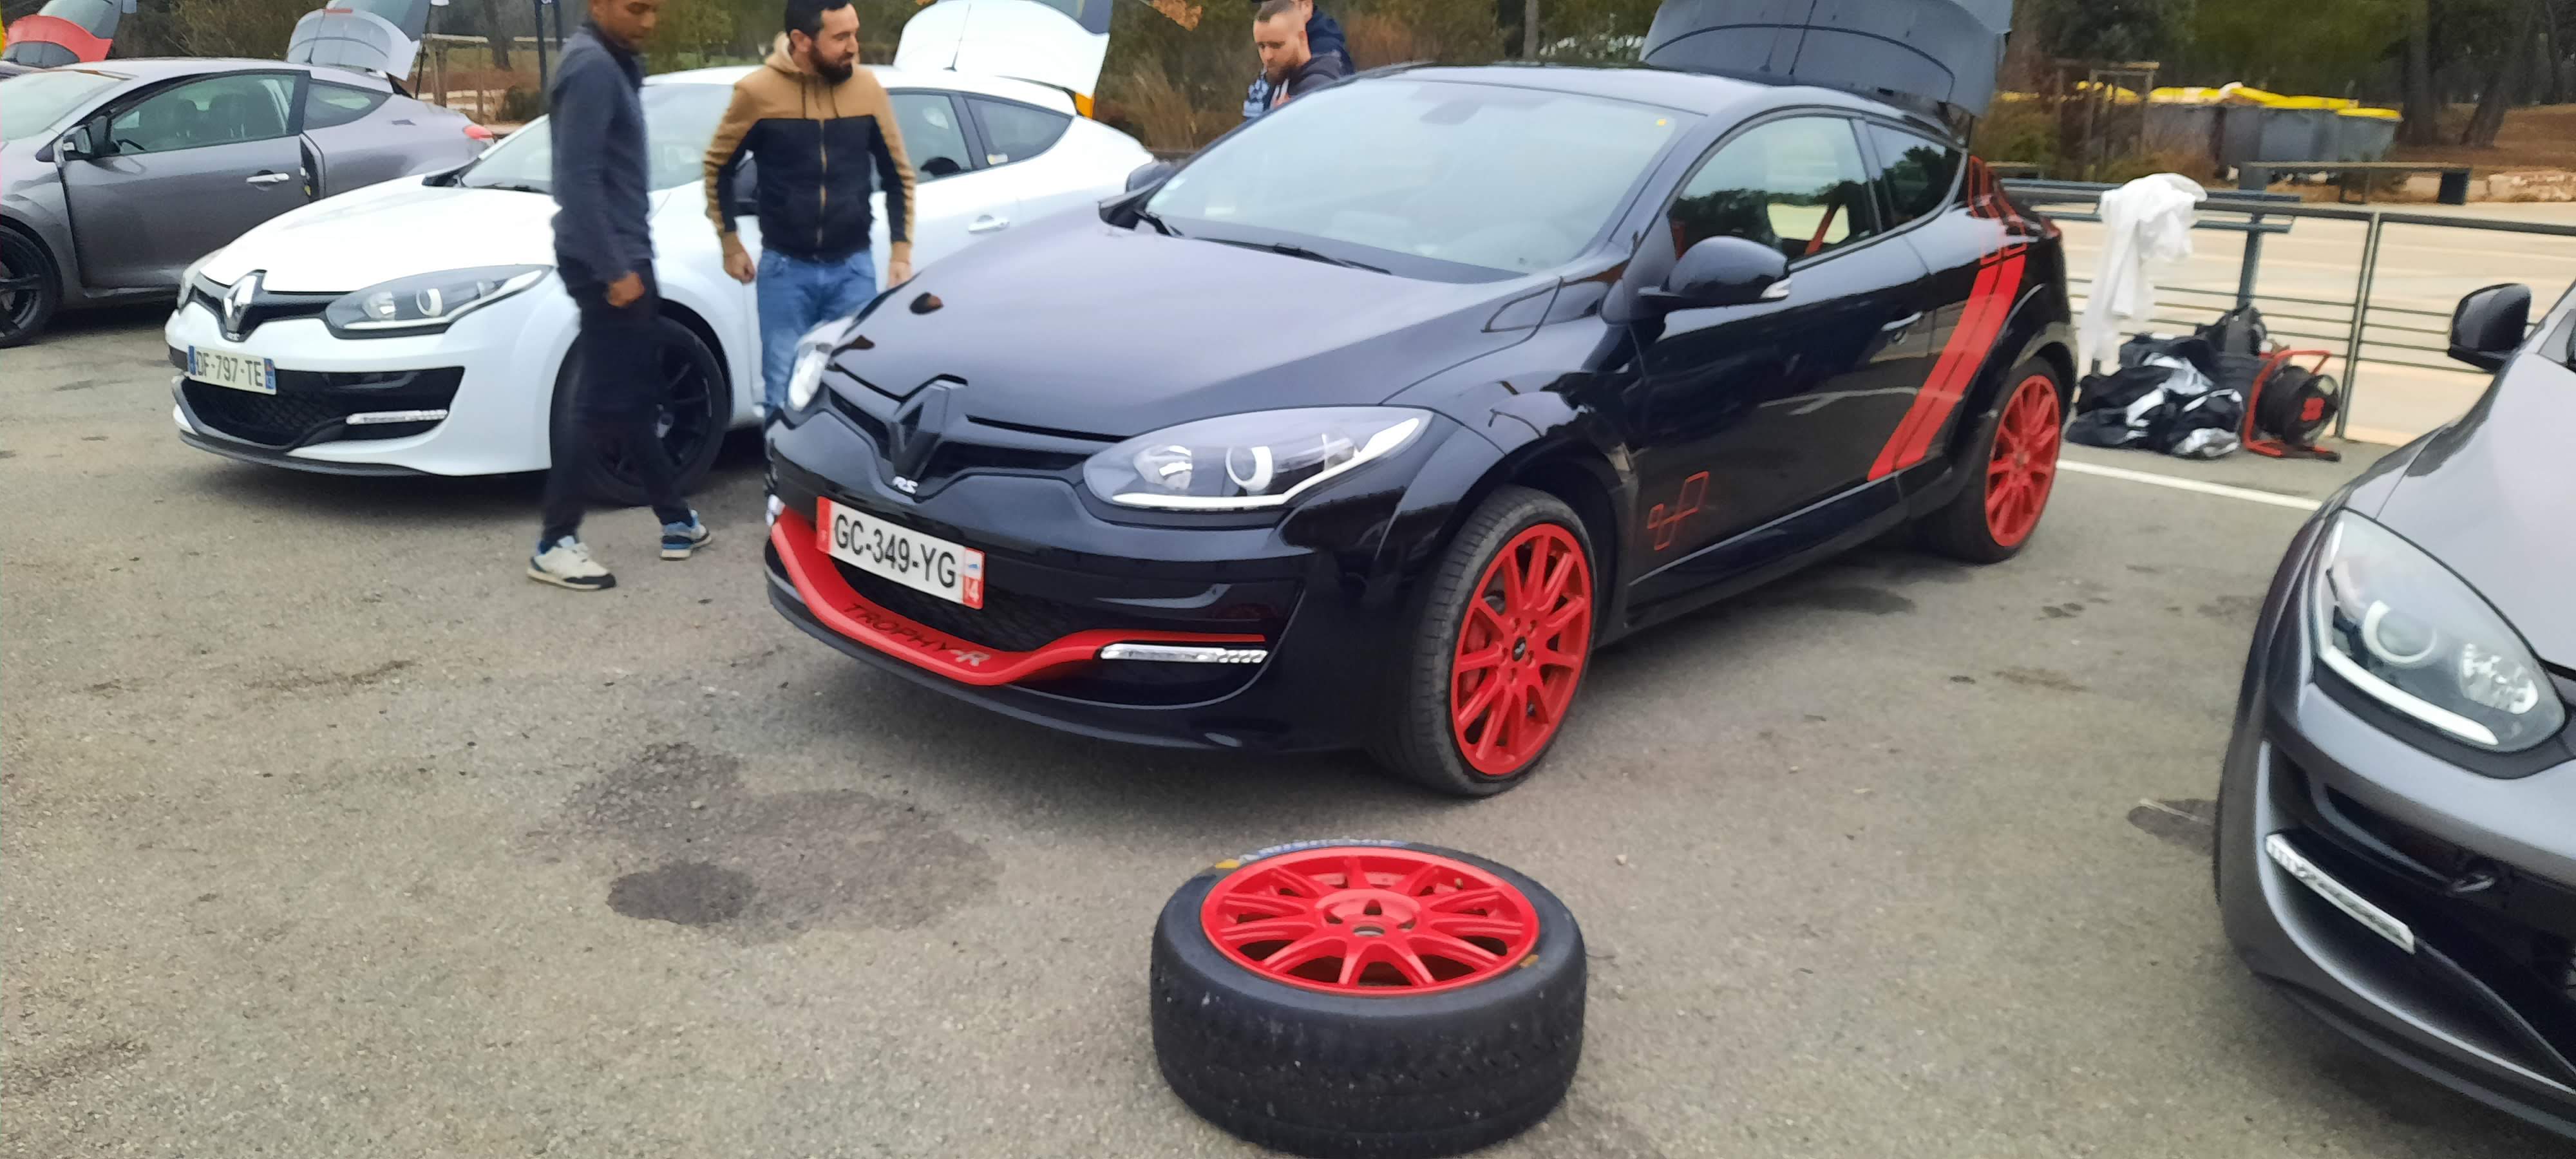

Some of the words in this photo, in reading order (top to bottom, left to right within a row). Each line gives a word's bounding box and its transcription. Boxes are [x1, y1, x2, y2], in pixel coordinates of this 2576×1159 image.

[196, 351, 263, 387] DF-797-TE
[835, 514, 956, 589] GC-349-YG
[844, 603, 992, 666] TROPHY-R
